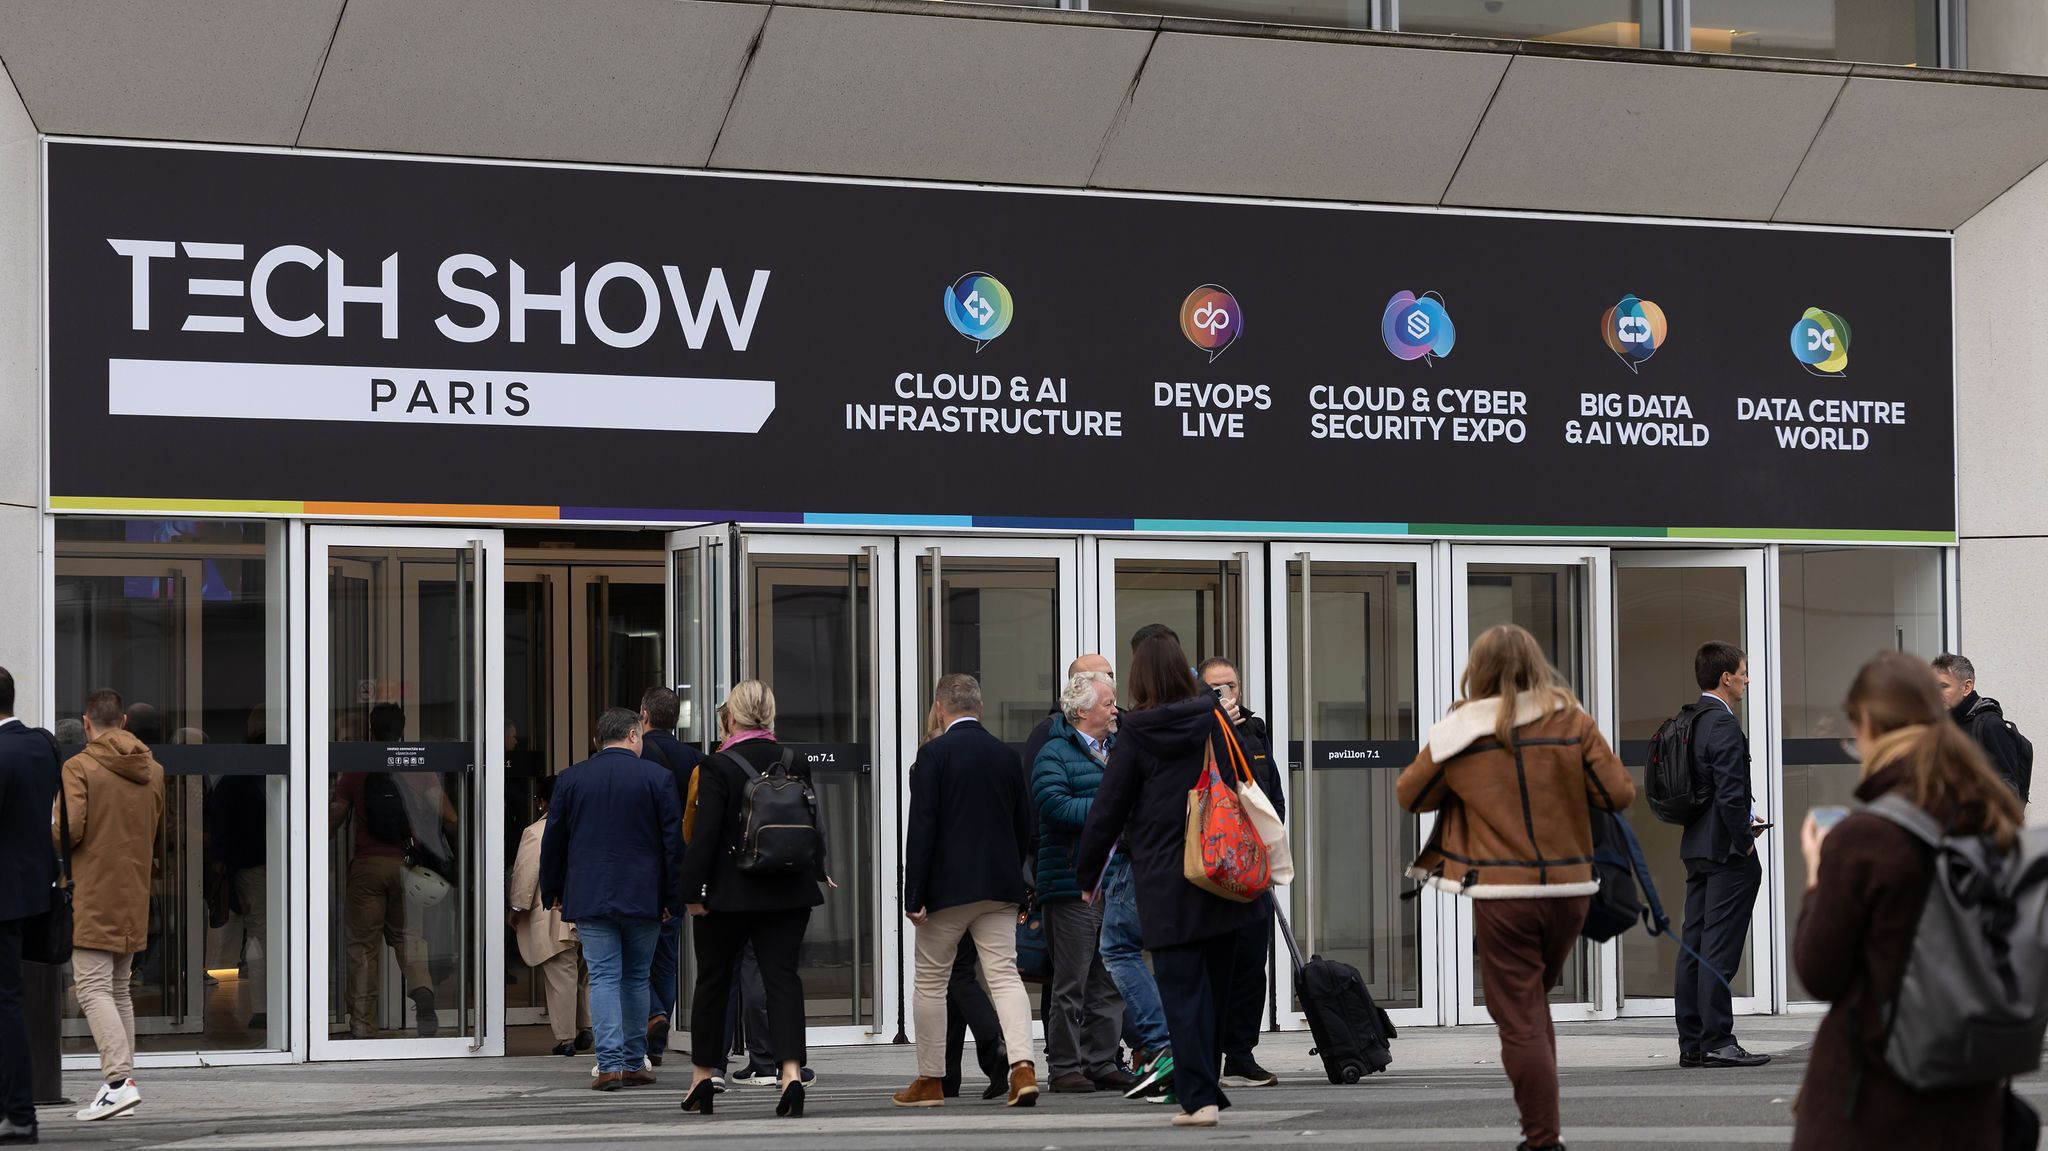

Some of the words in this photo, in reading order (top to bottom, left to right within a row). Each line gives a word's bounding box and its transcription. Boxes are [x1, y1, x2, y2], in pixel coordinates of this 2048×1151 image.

[107, 239, 399, 340] TECH
[435, 254, 771, 352] SHOW
[371, 379, 531, 417] PARIS
[895, 373, 1001, 401] CLOUD
[1010, 376, 1029, 402] &
[1036, 377, 1067, 403] AI
[1155, 382, 1271, 410] DEVOPS
[1310, 385, 1405, 412] CLOUD
[1412, 388, 1430, 412] &
[1436, 388, 1527, 415] CYBER
[1580, 393, 1622, 417] BIG
[1628, 395, 1693, 419] DATA
[1737, 398, 1804, 422] DATA
[1808, 399, 1906, 424] CENTRE
[846, 404, 1122, 437] INFRASTRUCTURE
[1183, 412, 1244, 438] LIVE
[1311, 414, 1446, 441] SECURITY
[1453, 418, 1526, 443] EXPO
[1566, 420, 1583, 444] &
[1586, 421, 1612, 445] AI
[1616, 421, 1709, 447] WORLD
[1775, 426, 1869, 451] WORLD
[820, 753, 835, 762] 7.1
[1328, 749, 1365, 760] pavillon
[1366, 750, 1380, 759] 7.1
